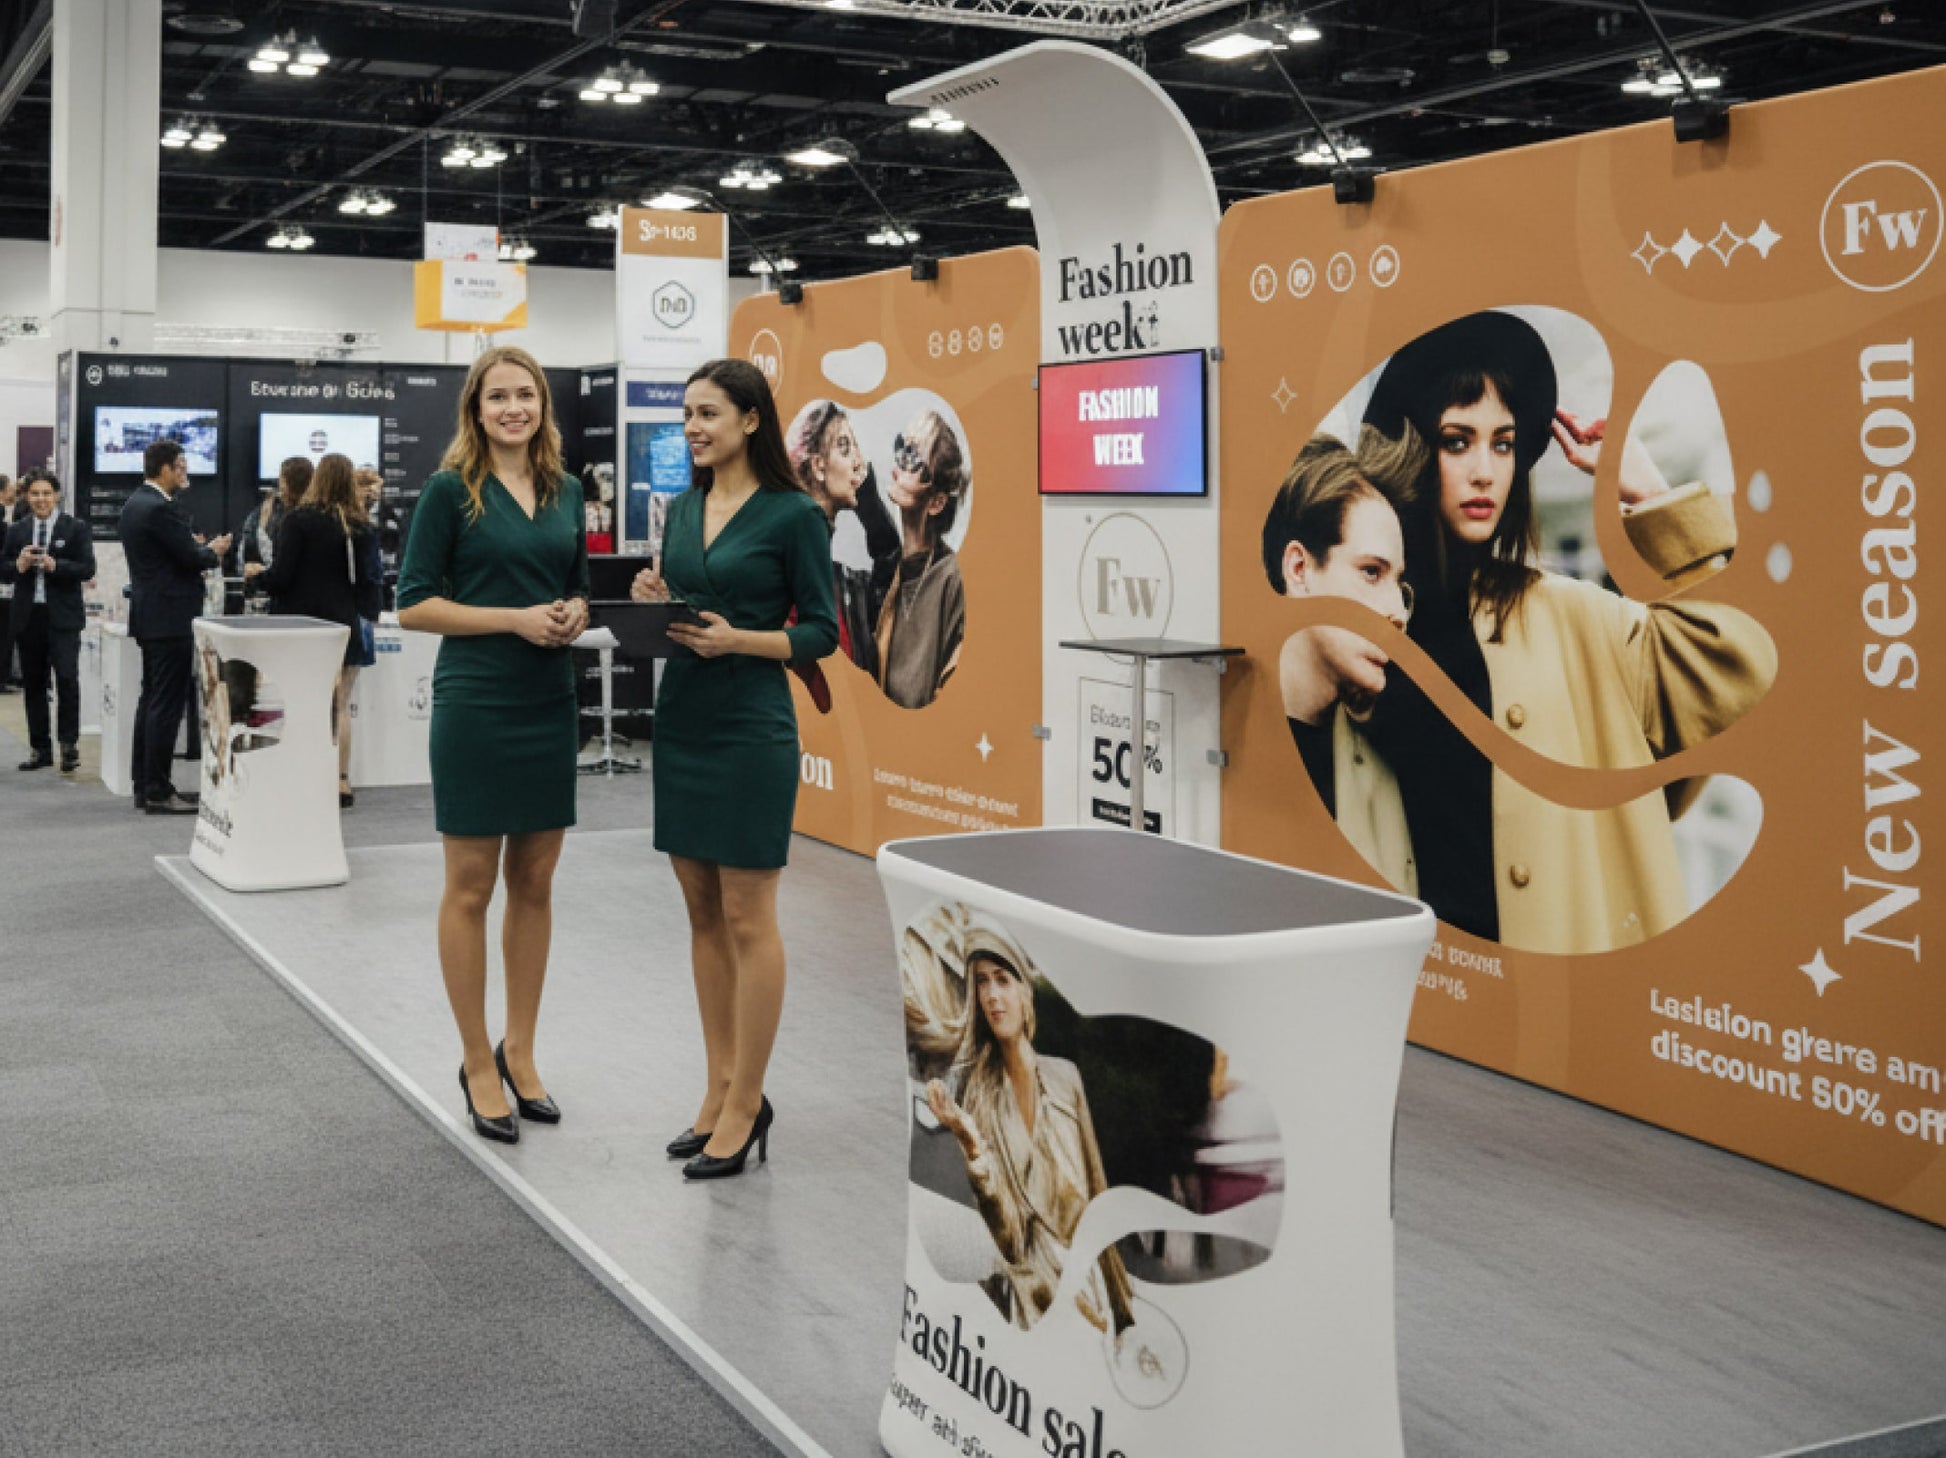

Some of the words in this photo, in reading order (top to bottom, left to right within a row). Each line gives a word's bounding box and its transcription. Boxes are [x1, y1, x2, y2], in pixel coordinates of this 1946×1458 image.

[1841, 199, 1928, 255] Fw
[1058, 242, 1194, 303] Fashion
[1077, 385, 1159, 422] FASHION
[1092, 432, 1145, 466] WEEK
[1859, 337, 1919, 690] season
[1096, 556, 1161, 619] Fw
[1843, 717, 1922, 963] New
[901, 1283, 1032, 1438] Fashion
[1042, 1404, 1126, 1458] sal
